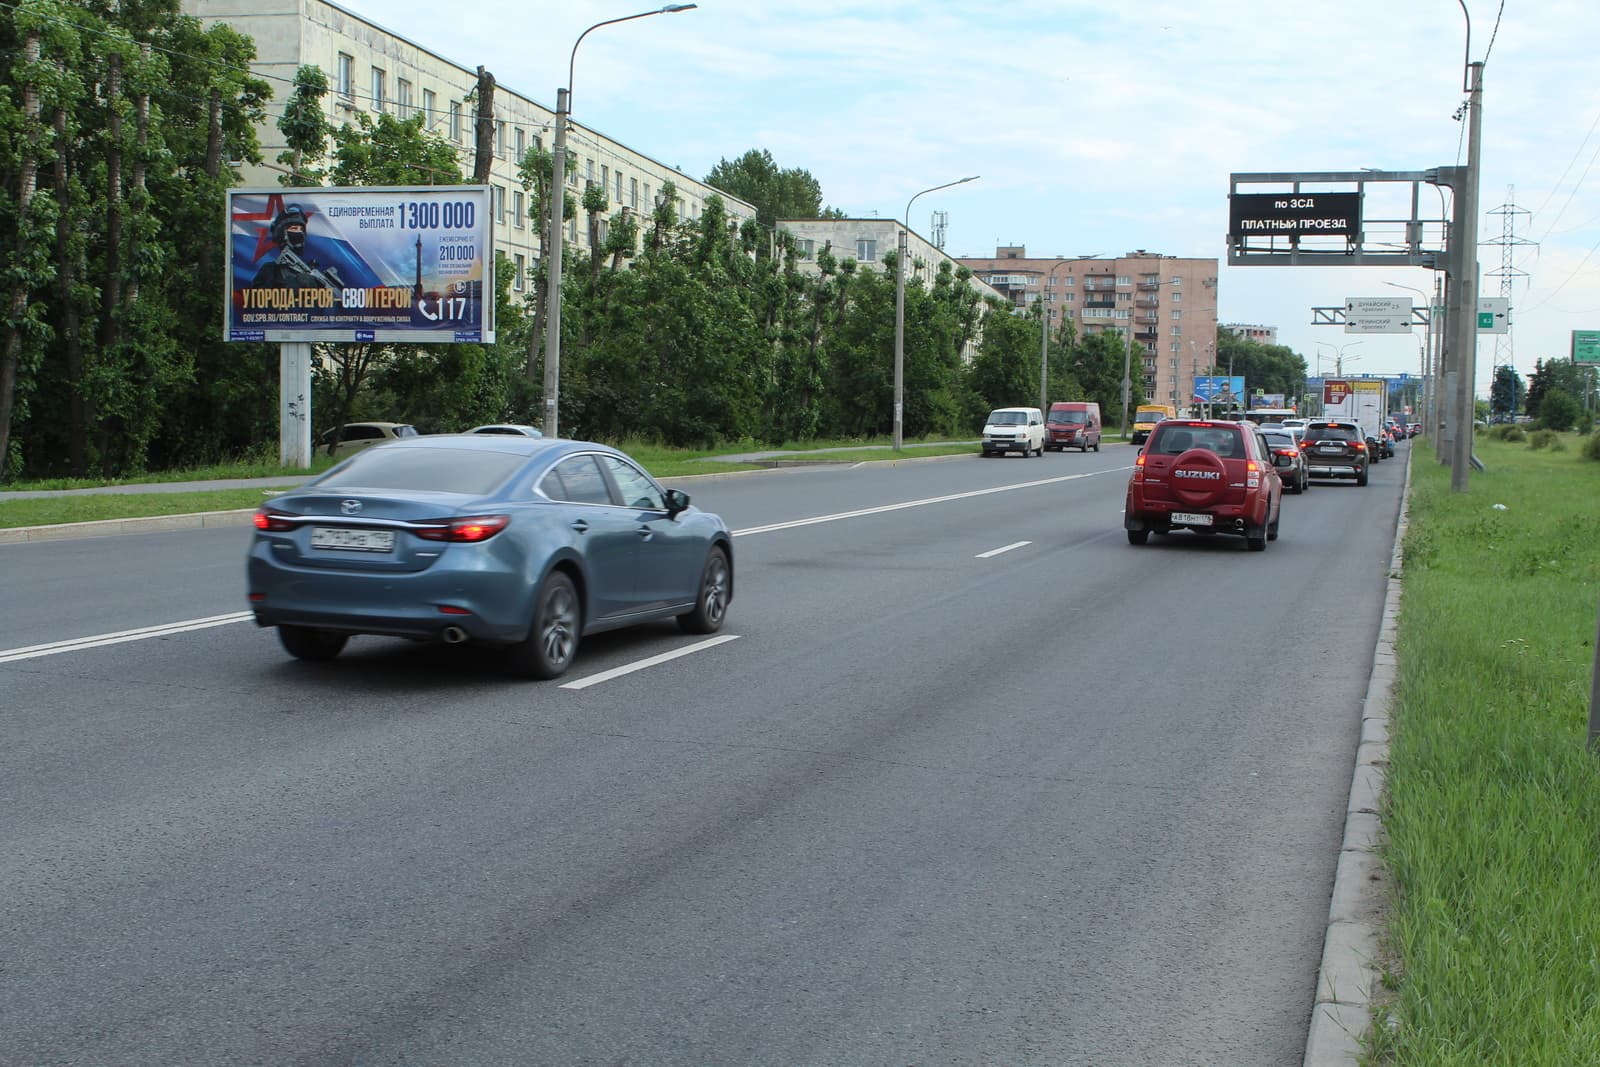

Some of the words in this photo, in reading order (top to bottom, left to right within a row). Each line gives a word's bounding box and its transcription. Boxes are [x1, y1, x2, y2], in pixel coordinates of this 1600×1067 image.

[1290, 199, 1314, 208] ЗСД
[328, 206, 395, 217] ЕДИНОВРЕМЕННАЯ
[398, 202, 406, 229] 1
[408, 202, 439, 229] 300
[443, 202, 475, 229] 000
[359, 219, 395, 229] ВЫПЛАТА
[1241, 220, 1297, 230] ПЛАТНЫЙ
[1299, 219, 1347, 229] ПРОЕЗД
[440, 246, 455, 260] 210
[457, 246, 474, 260] 000
[242, 288, 250, 308] У
[251, 288, 333, 310] ГОРОДА-ГЕРОЯ
[342, 288, 373, 308] СВОИ
[436, 297, 466, 320] 117
[1174, 470, 1220, 480] SUZUKI
